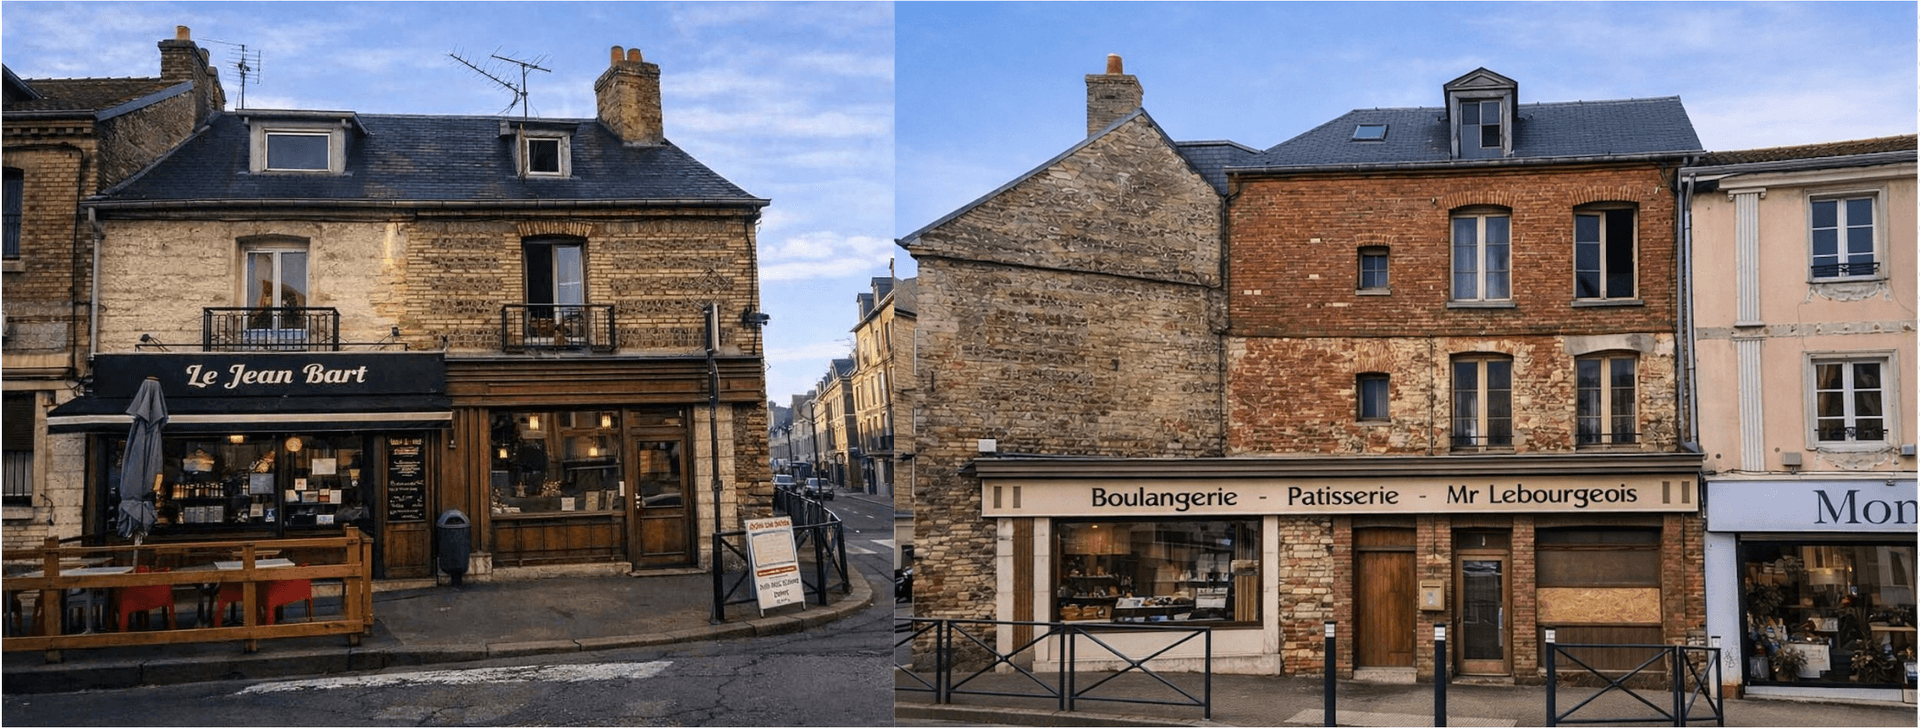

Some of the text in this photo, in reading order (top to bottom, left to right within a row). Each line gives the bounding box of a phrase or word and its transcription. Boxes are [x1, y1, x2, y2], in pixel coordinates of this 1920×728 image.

[185, 362, 369, 390] Le Jean Bart
[1091, 486, 1238, 512] Boulangerie
[1288, 486, 1399, 506] Patisserie
[1446, 485, 1480, 504] Mr
[1489, 484, 1638, 509] Lebourgeois
[1813, 489, 1918, 525] Mon
